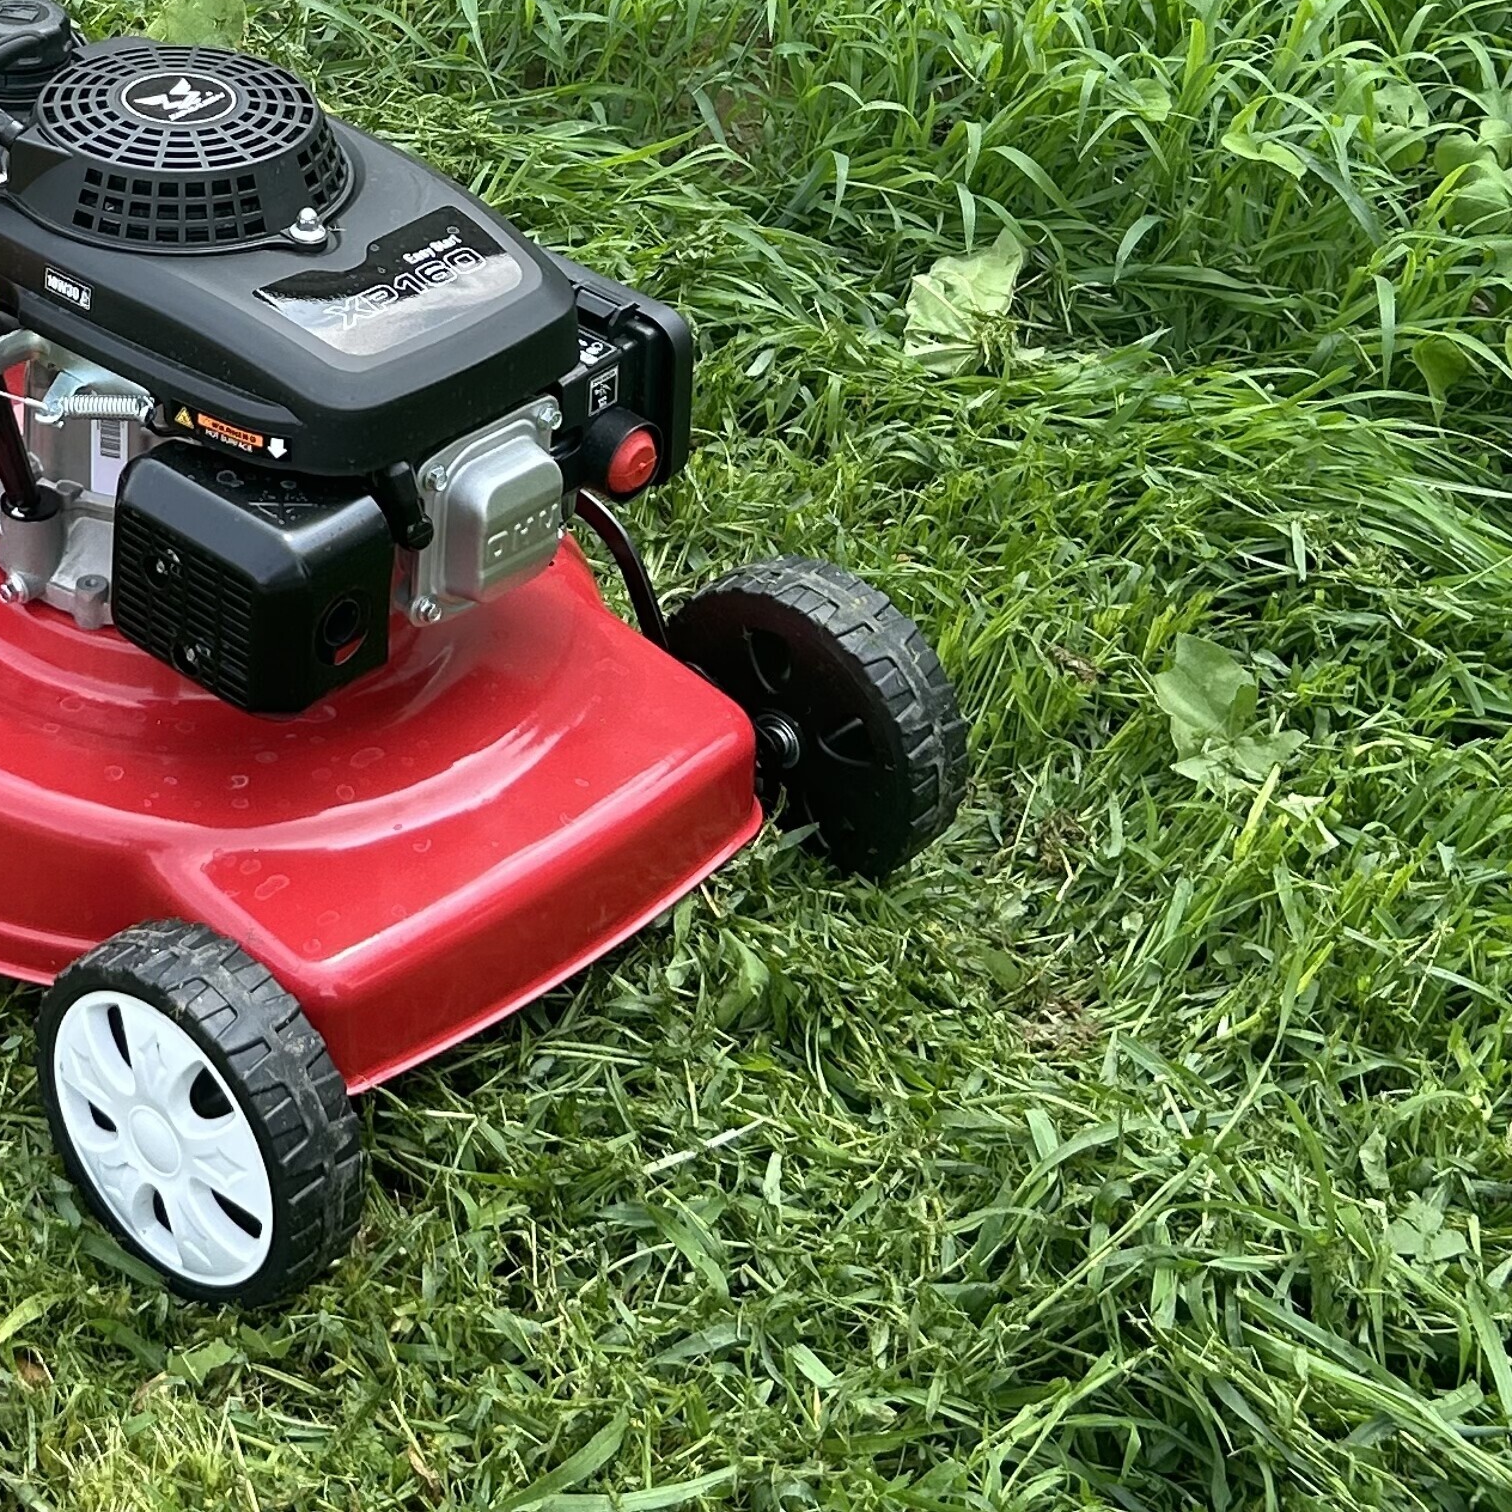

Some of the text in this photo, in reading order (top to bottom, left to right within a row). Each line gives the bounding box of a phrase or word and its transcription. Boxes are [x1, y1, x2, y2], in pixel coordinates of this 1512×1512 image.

[402, 234, 462, 264] Easy Start
[324, 247, 487, 330] XP160
